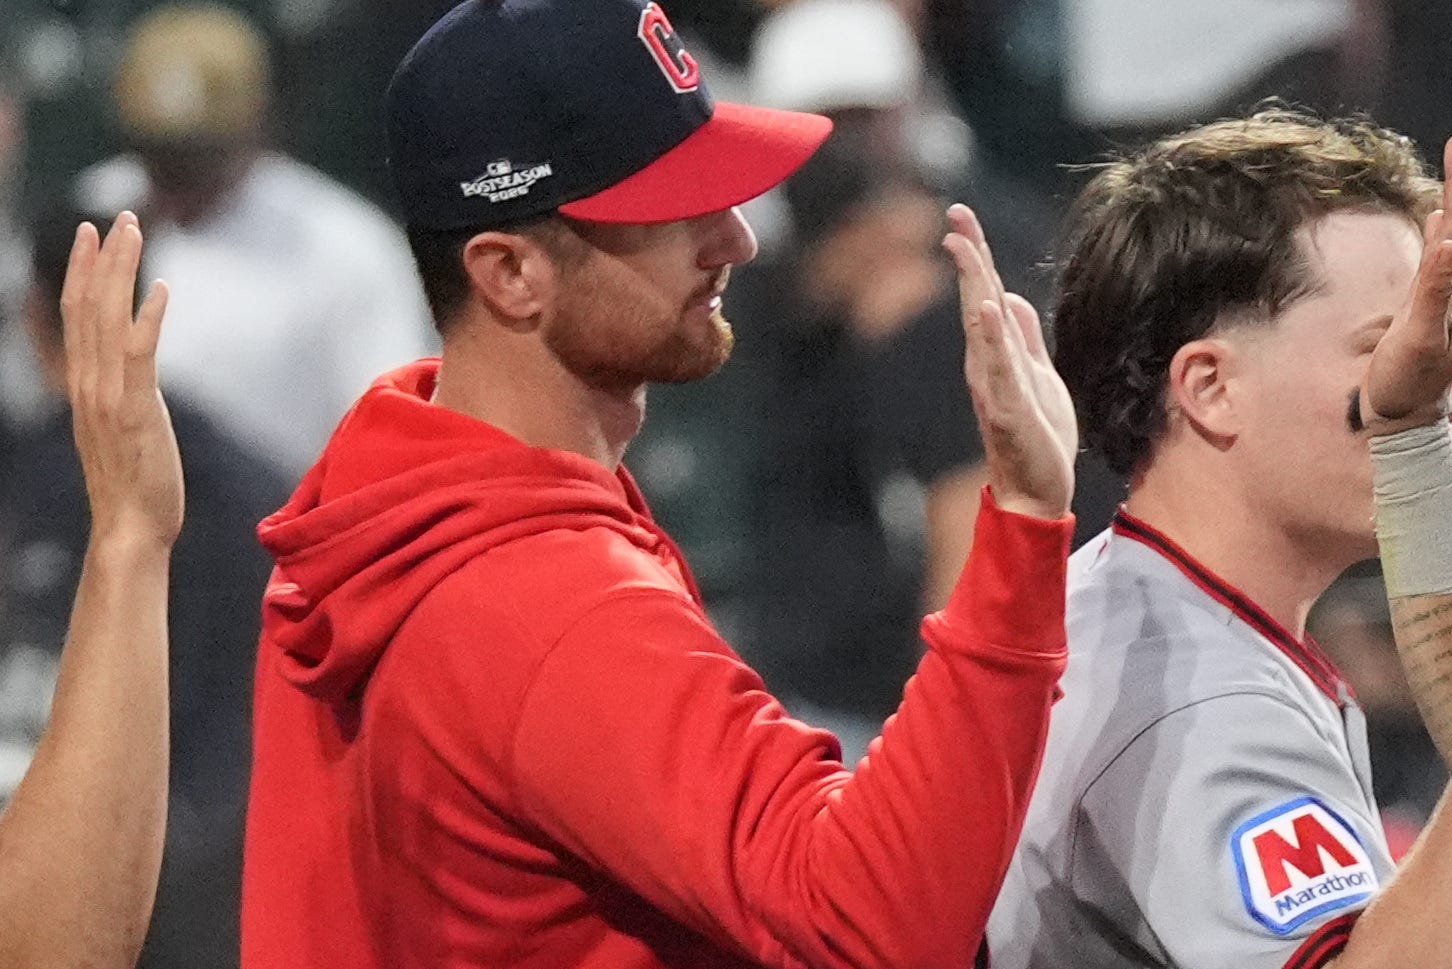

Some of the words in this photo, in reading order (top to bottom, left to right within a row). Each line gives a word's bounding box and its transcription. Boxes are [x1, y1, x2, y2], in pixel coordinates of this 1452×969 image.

[460, 163, 553, 197] POSTSEASON
[1252, 813, 1359, 898] M
[1274, 872, 1372, 917] Marathon
